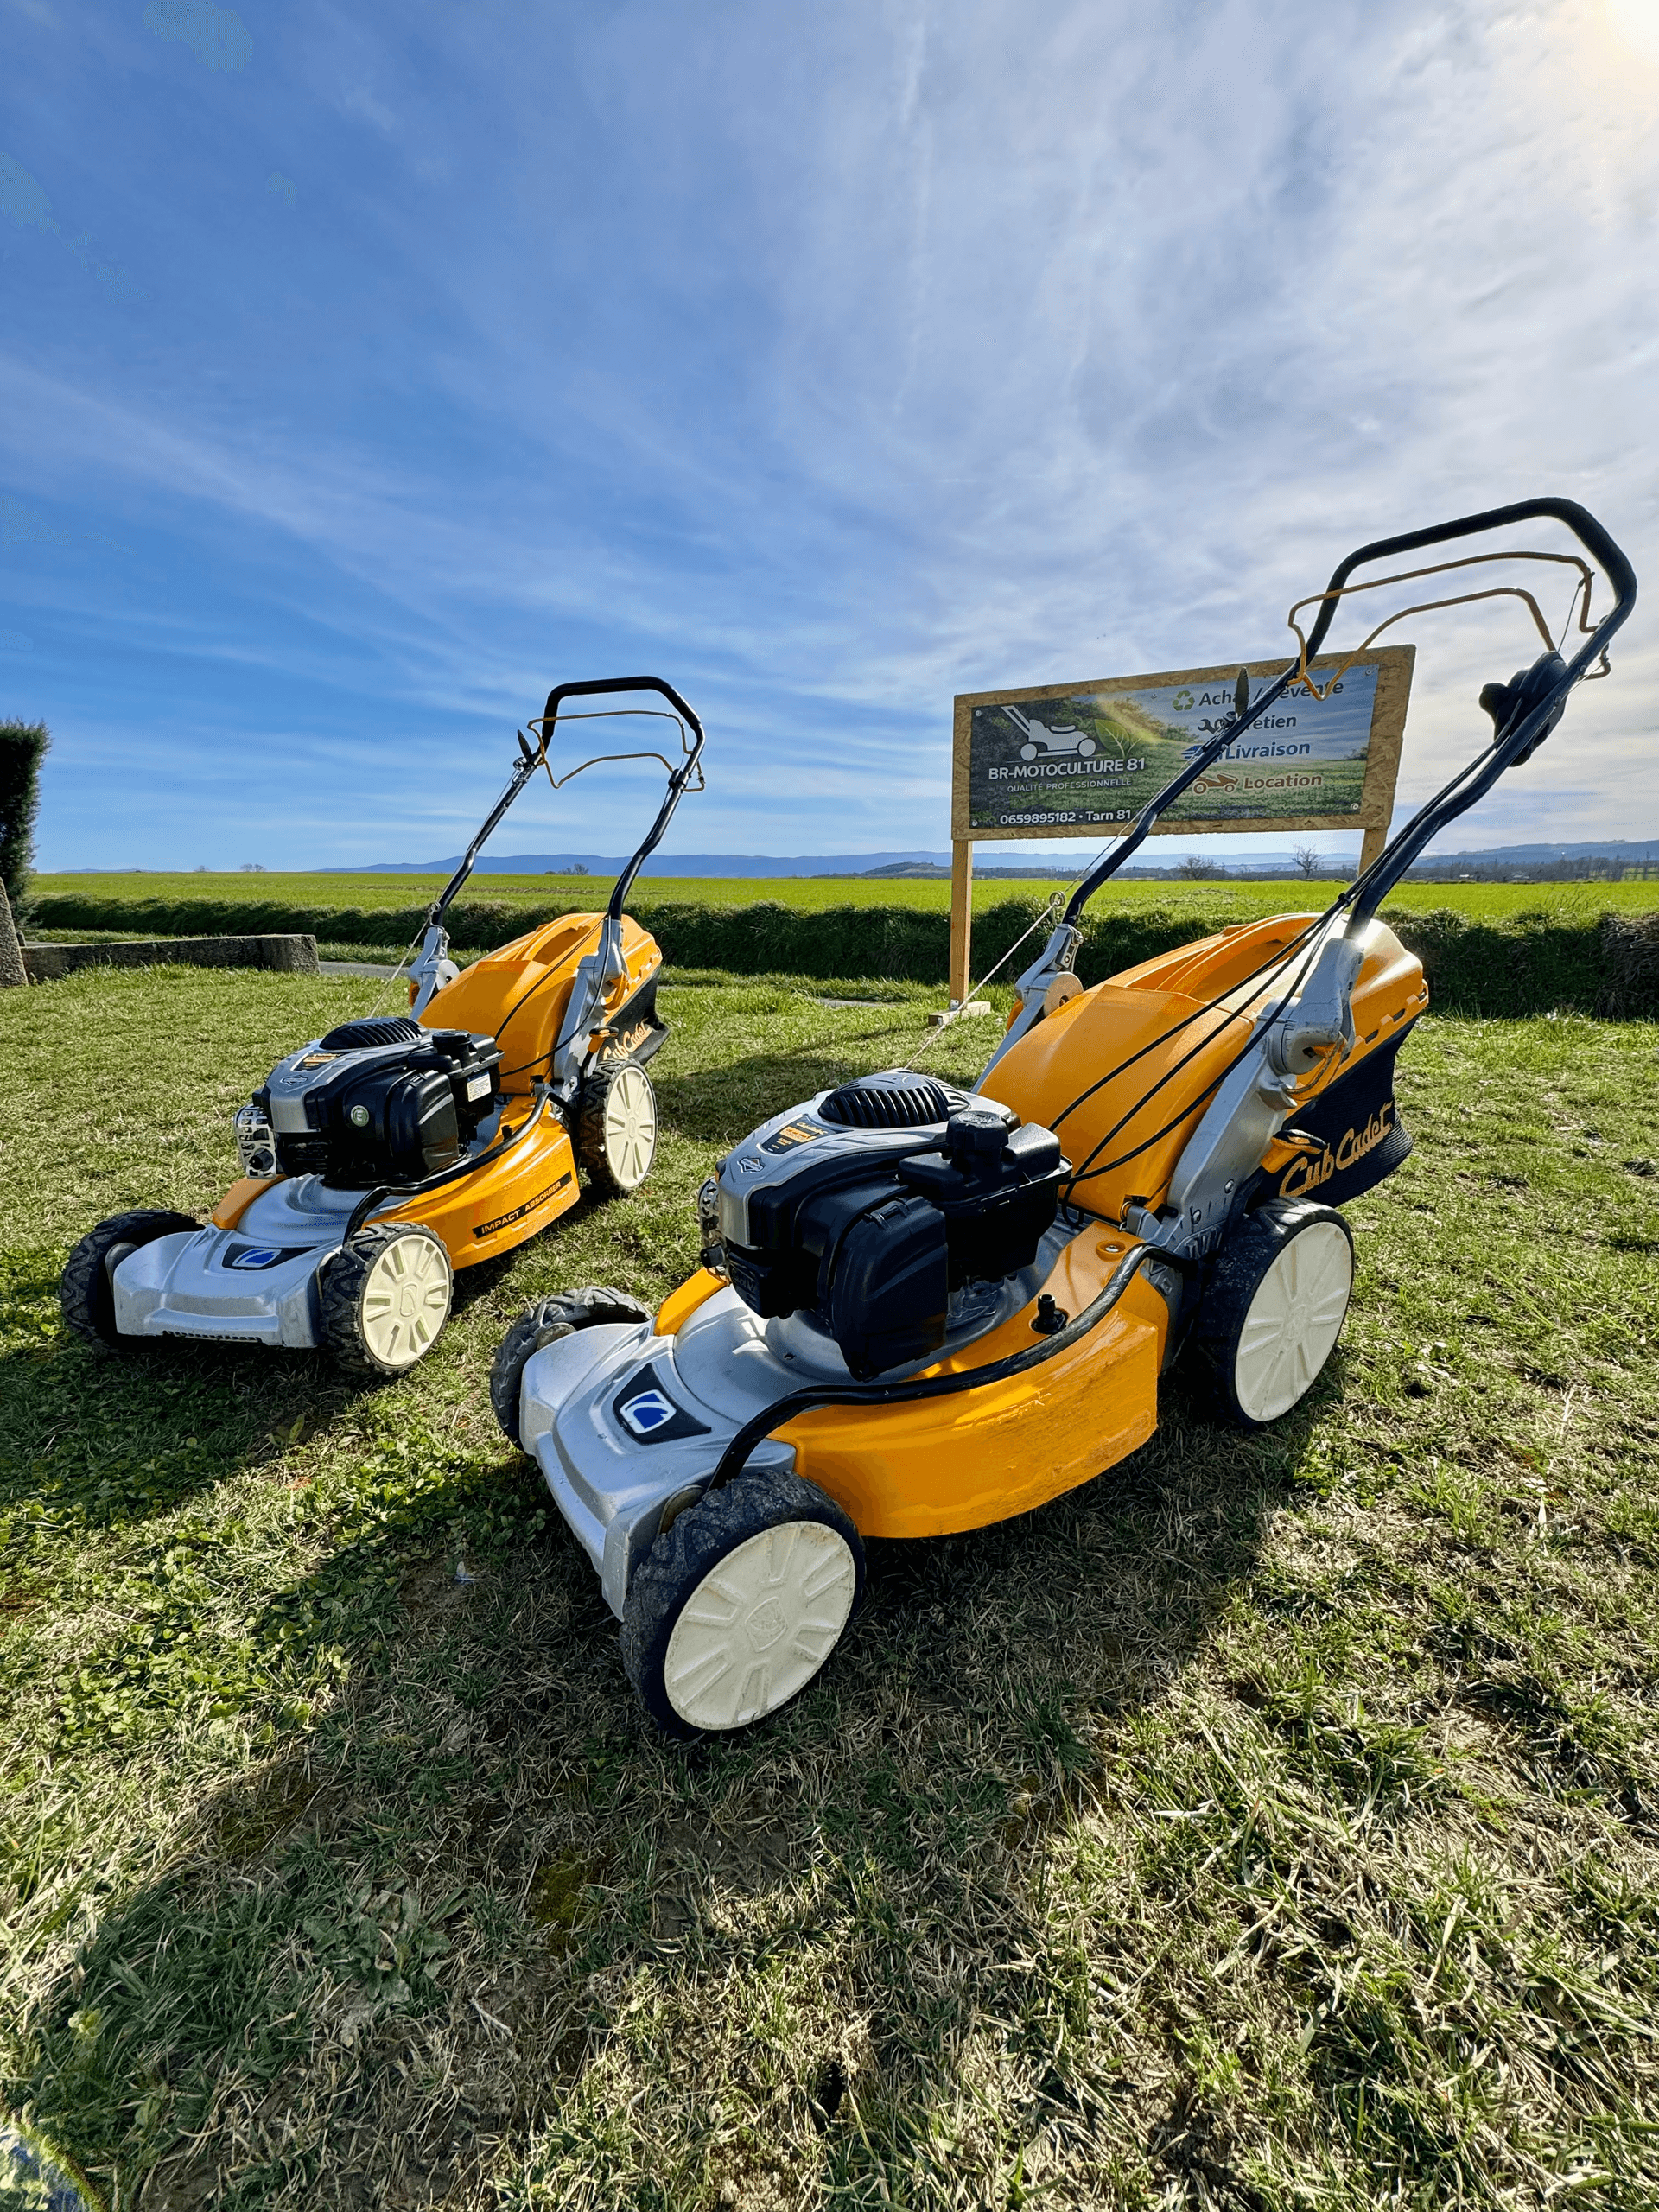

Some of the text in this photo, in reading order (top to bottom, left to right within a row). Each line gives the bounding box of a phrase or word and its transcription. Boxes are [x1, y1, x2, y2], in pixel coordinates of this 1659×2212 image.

[1198, 689, 1242, 707] Ach
[1225, 741, 1311, 760] Livraison
[988, 757, 1145, 779] BR-MOTOCULTURE 81
[1046, 778, 1132, 790] PROFESSIONNELLE
[1243, 772, 1323, 790] Location
[1000, 812, 1077, 825] 0659895182
[1085, 810, 1114, 822] Tarn
[1116, 809, 1132, 820] 81
[1279, 1102, 1393, 1198] Cub Cadet
[480, 1180, 562, 1235] IMPACT ABSORBER
